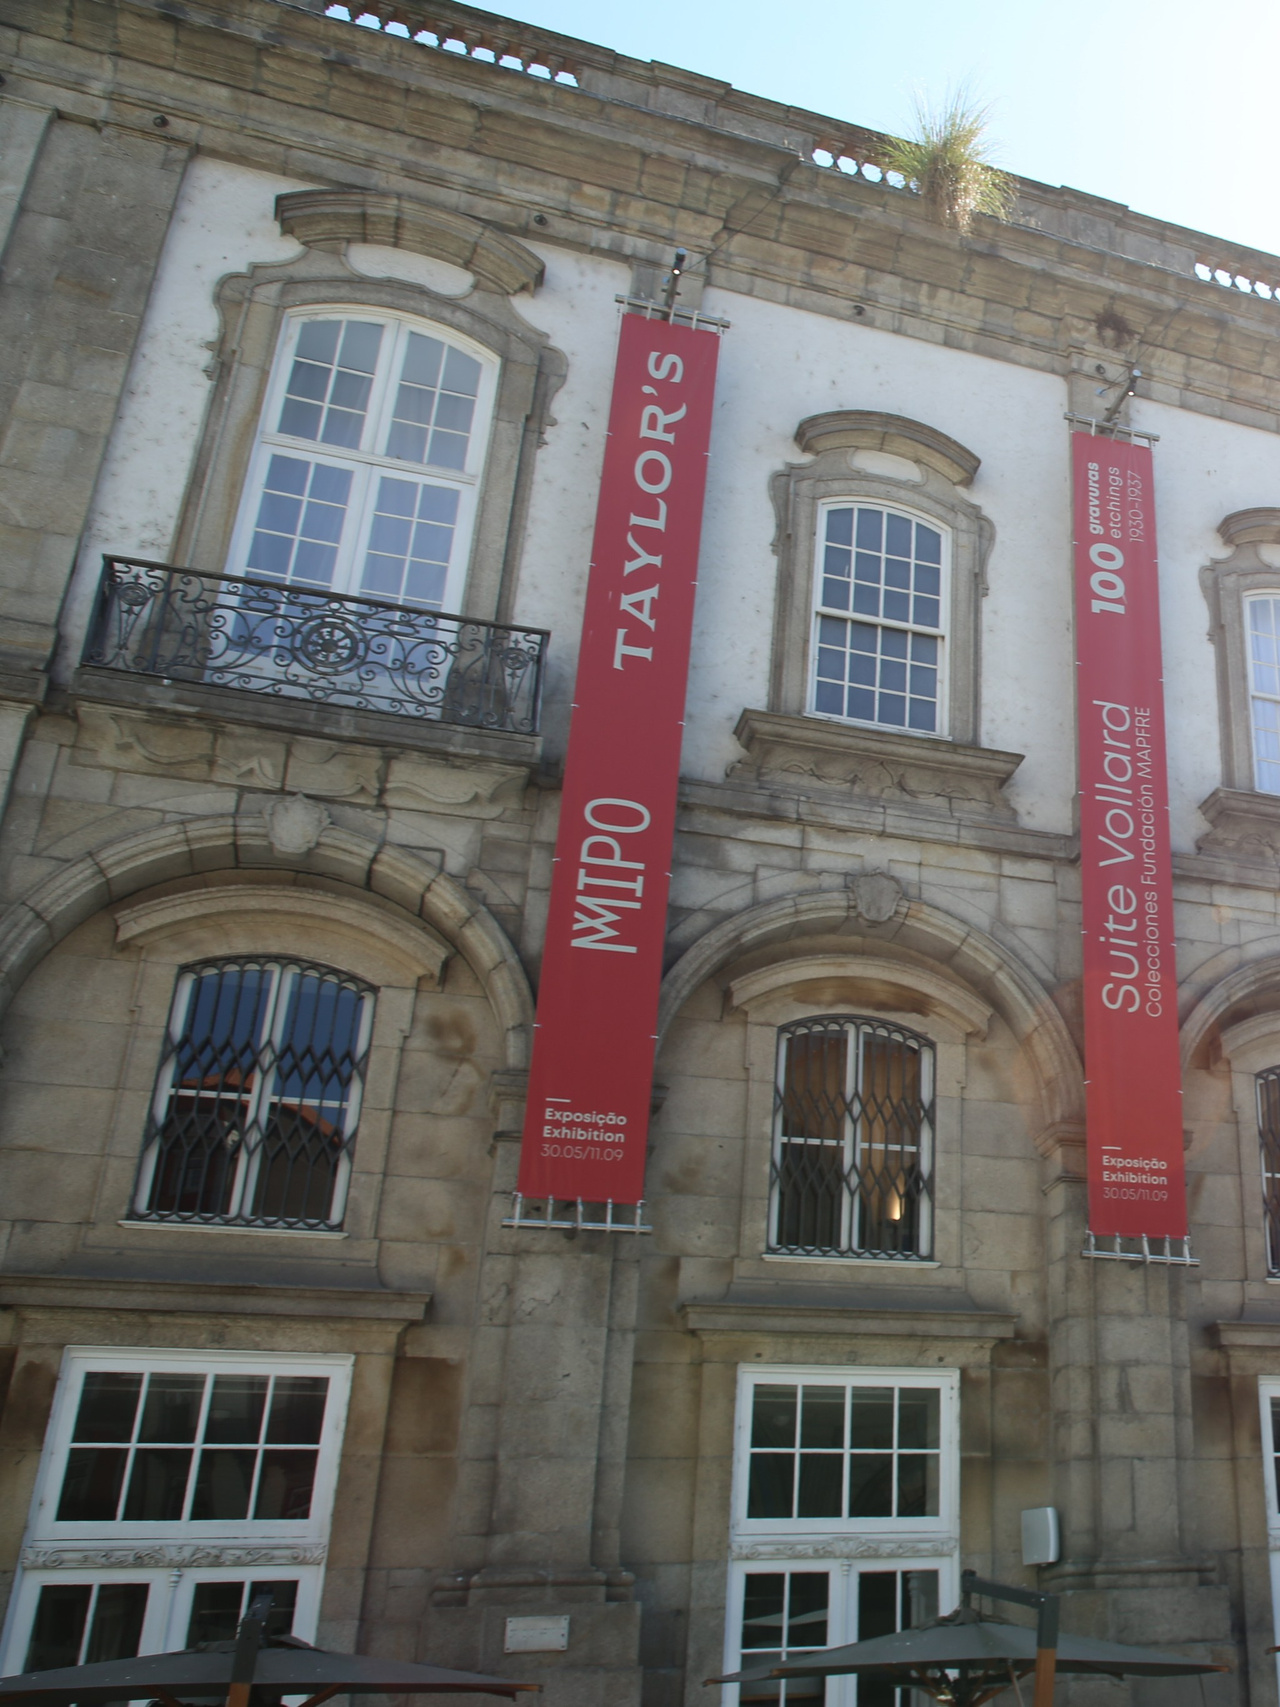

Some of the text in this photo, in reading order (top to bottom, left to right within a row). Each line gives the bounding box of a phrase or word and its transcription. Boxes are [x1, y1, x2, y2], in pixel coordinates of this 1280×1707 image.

[613, 351, 687, 670] TAYLOR'S
[1106, 466, 1123, 539] etchings
[1127, 470, 1145, 542] 1930-1937
[1088, 462, 1126, 614] 100 gravuras
[1092, 700, 1141, 1013] Suite Vollard
[1134, 706, 1162, 1018] Colecciones Fundación MAPFRE
[543, 1126, 625, 1143] Exhibition
[544, 1108, 627, 1127] Exposição
[540, 1144, 624, 1161] 30.05/11.09
[1102, 1155, 1168, 1171] Exposição
[1102, 1171, 1168, 1185] Exhibition
[1103, 1187, 1168, 1202] 30.05/11.09
